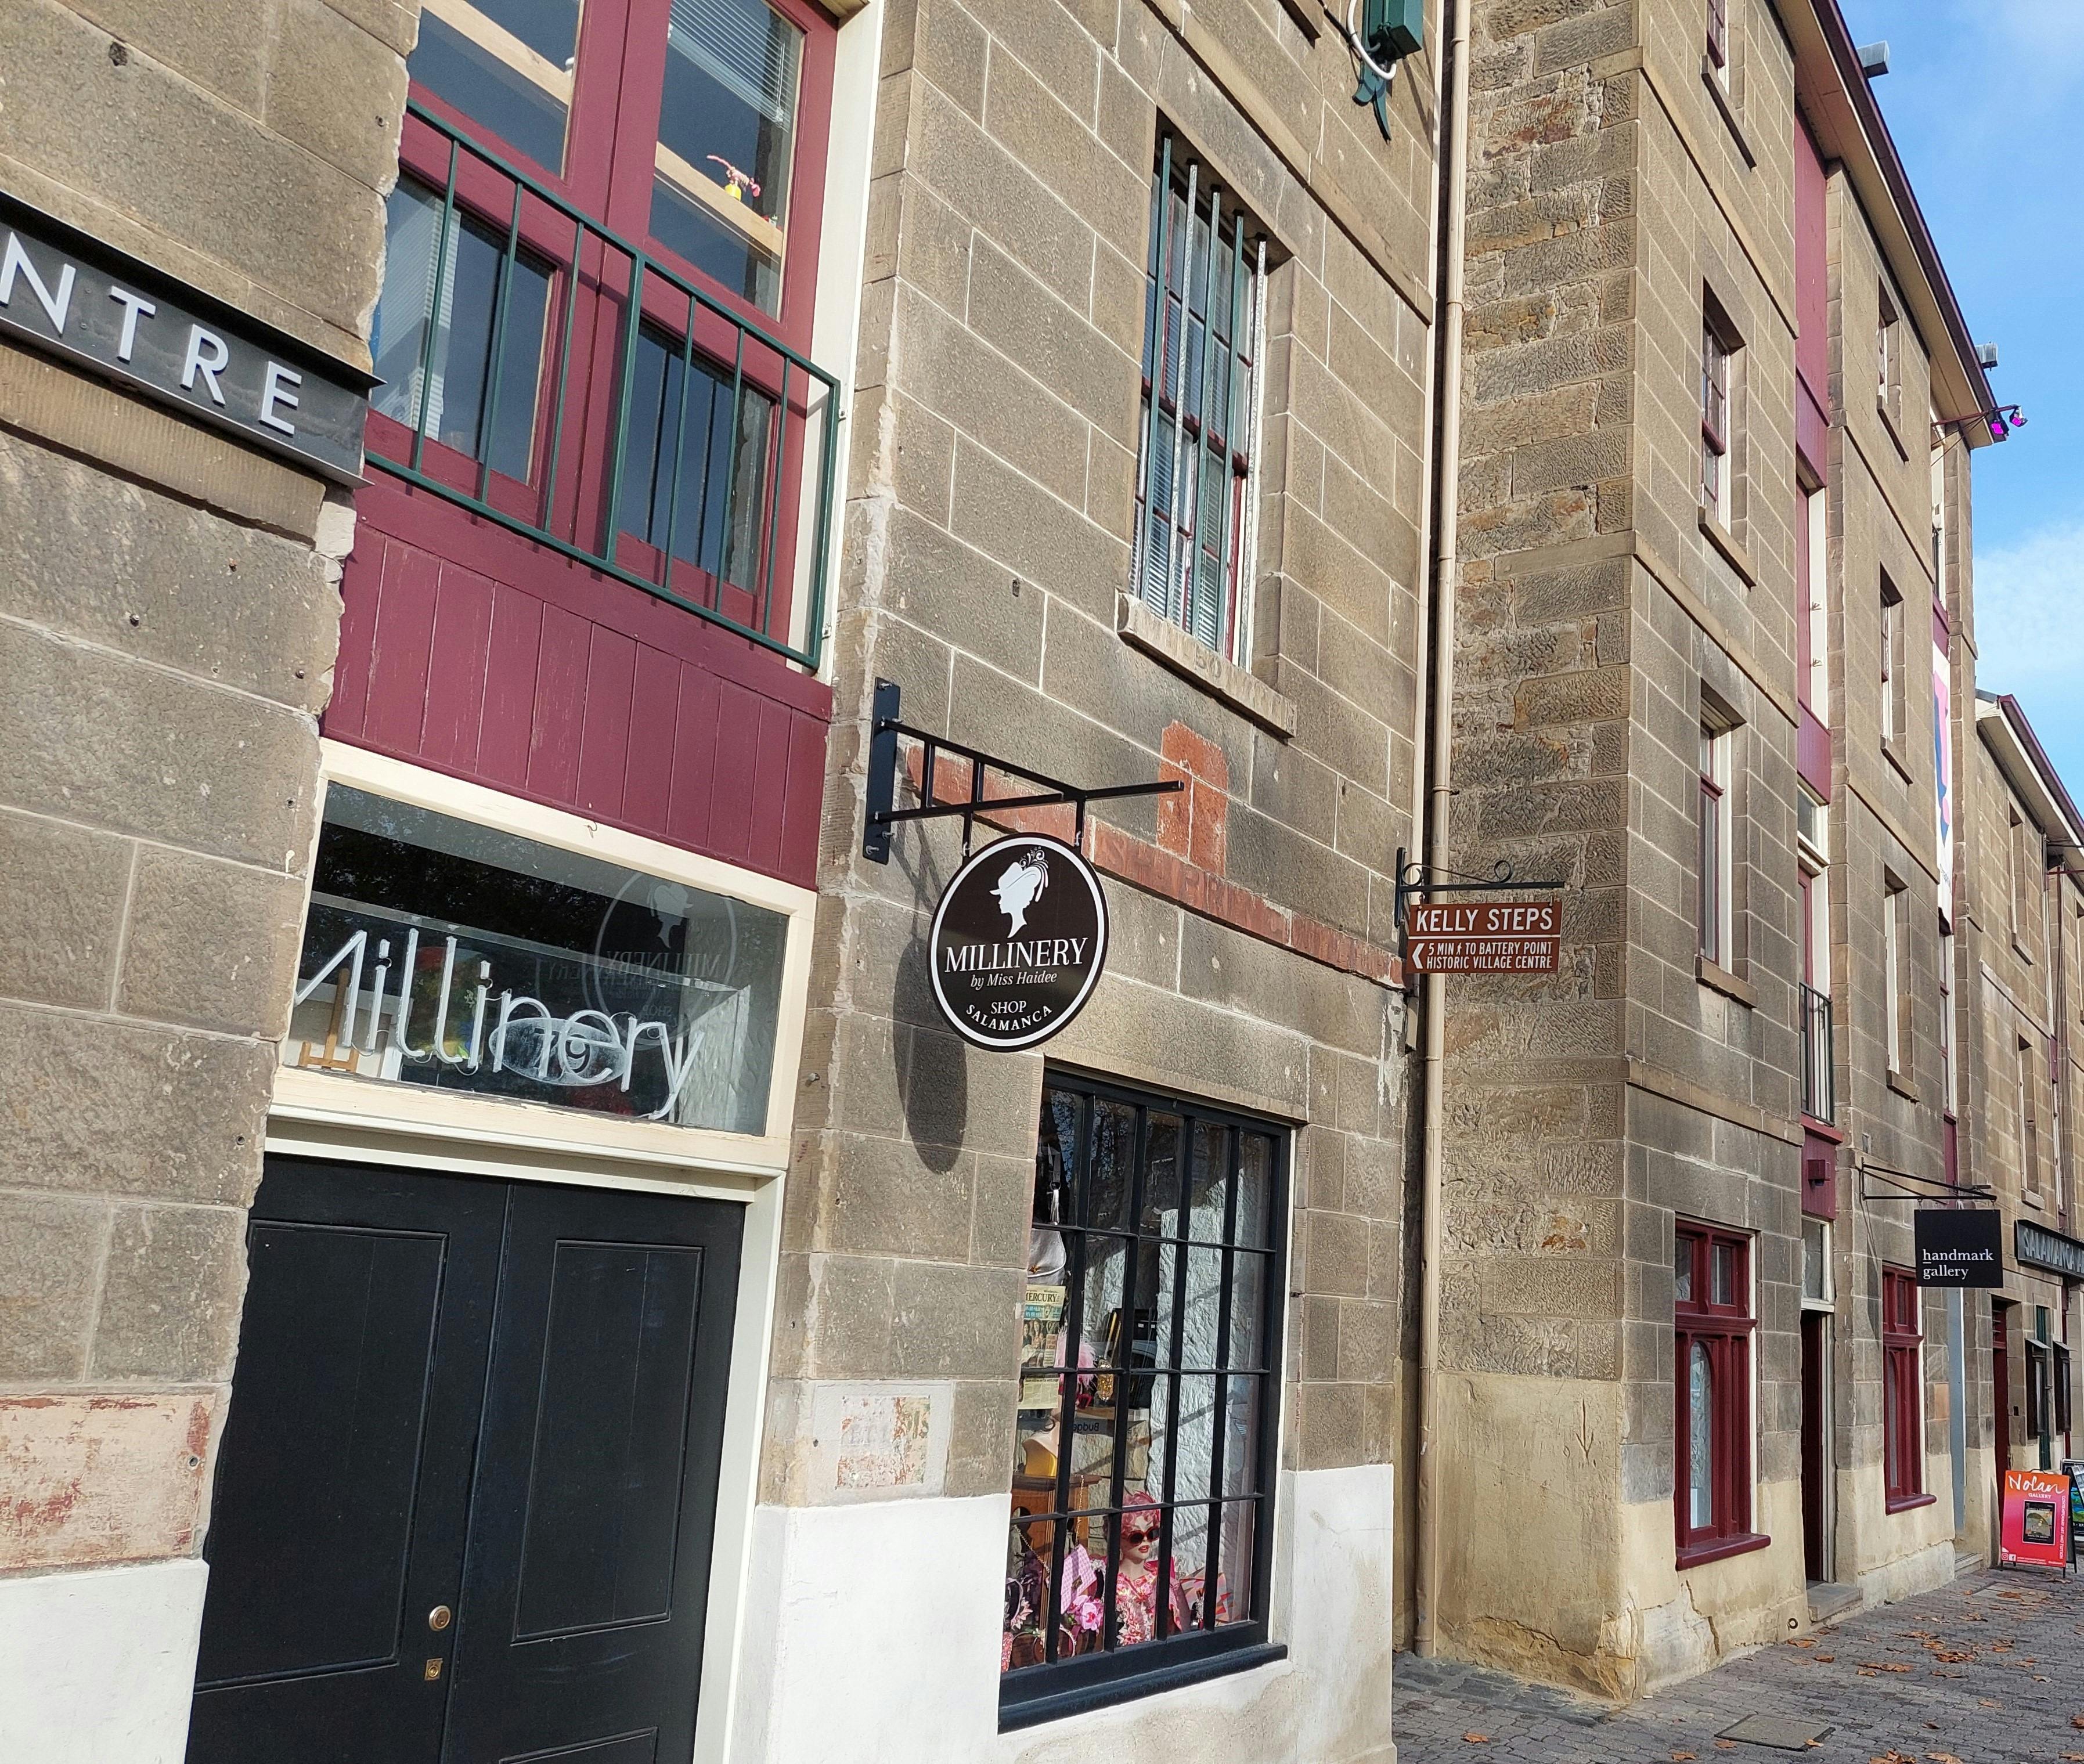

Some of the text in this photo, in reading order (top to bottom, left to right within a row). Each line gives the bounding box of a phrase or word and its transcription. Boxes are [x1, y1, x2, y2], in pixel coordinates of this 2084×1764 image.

[0, 232, 302, 436] NTRE
[1416, 908, 1553, 932] KELLY STEPS
[944, 937, 1088, 972] MILLINERY
[1428, 941, 1553, 955] 5 MIN TO BATTERY POINT
[1426, 955, 1553, 969] HISTORIC VILLAGE CENTRE
[970, 971, 1057, 991] by Miss Haidee
[966, 1004, 1052, 1031] SALAMANCA
[990, 1001, 1027, 1014] SHOP
[1922, 1249, 1994, 1262] handmark
[2024, 1228, 2075, 1271] SALAMANCA
[1923, 1265, 1969, 1280] gallery
[2008, 1473, 2065, 1495] Nolan
